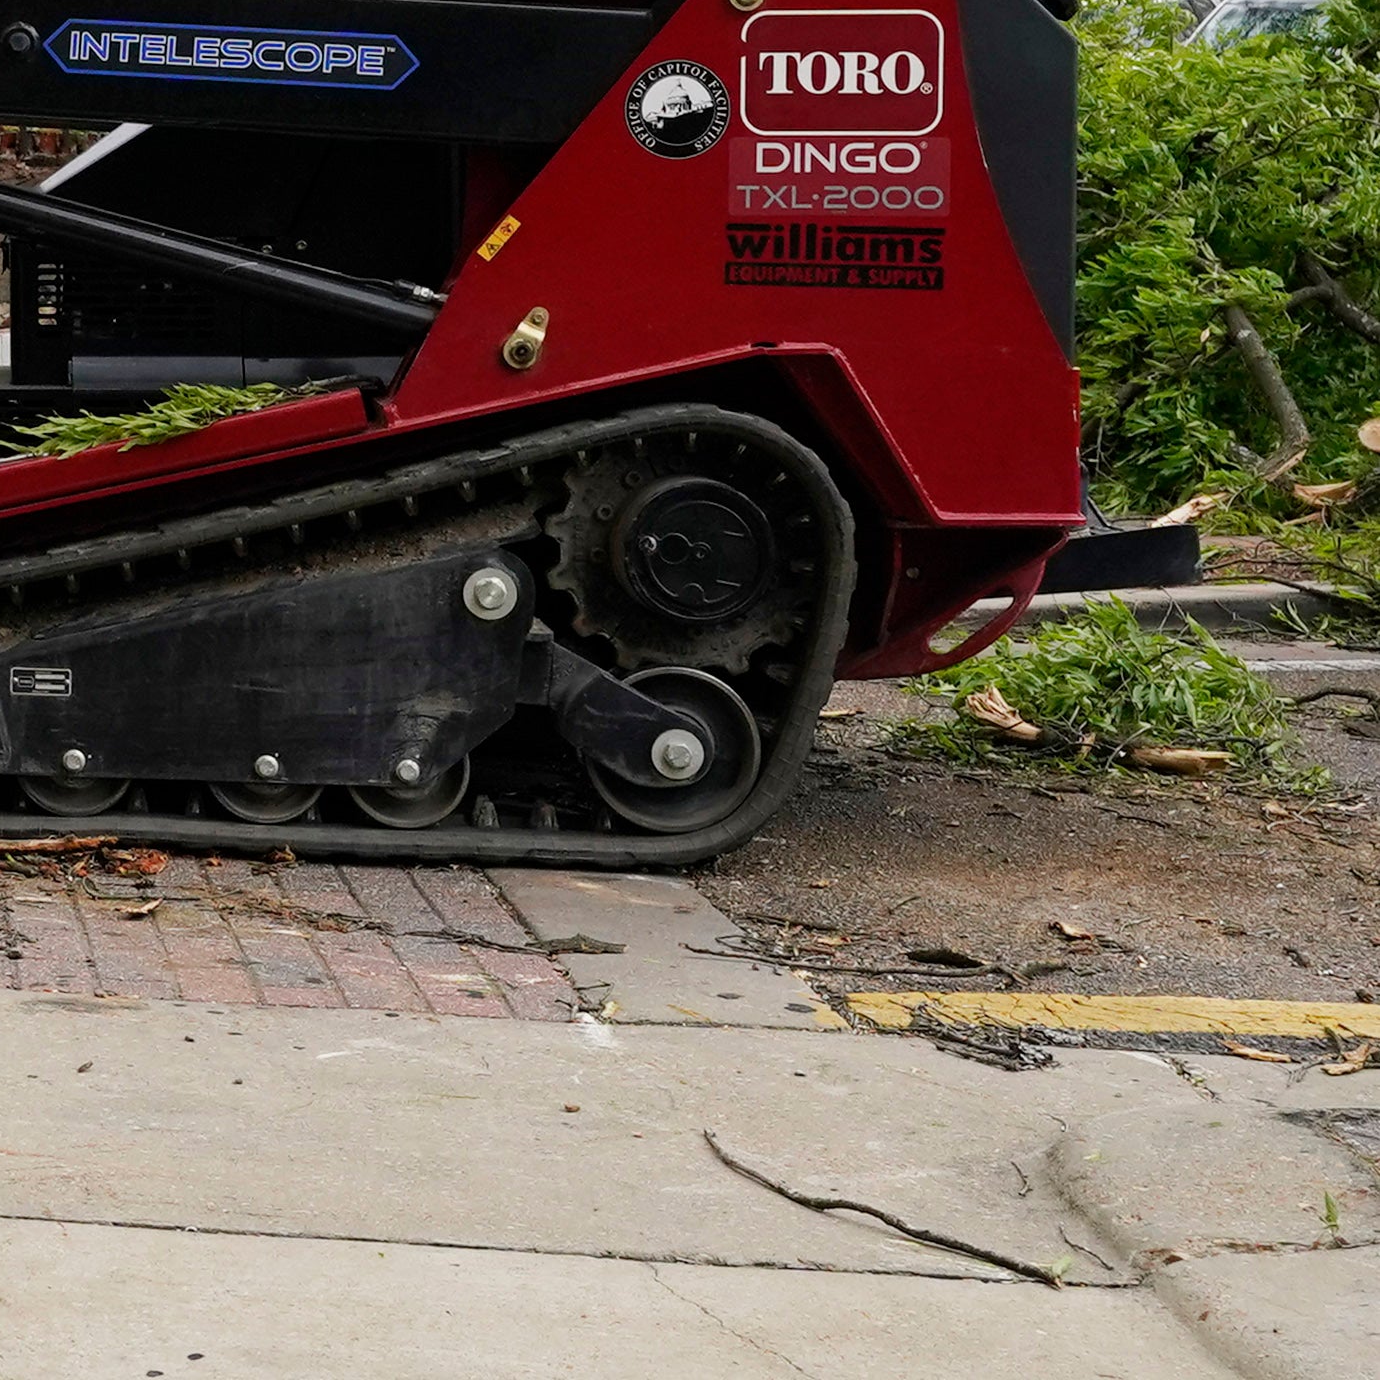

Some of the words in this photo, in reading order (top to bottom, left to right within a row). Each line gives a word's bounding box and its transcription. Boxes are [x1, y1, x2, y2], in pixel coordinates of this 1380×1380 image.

[69, 31, 385, 76] INTELESCOPE
[647, 63, 707, 82] CAPITOL
[758, 50, 926, 95] TORO
[632, 79, 647, 98] OF
[628, 101, 656, 148] OFFICE
[694, 80, 728, 151] FACILITIES
[755, 142, 922, 174] DINGO
[726, 223, 945, 264] williams
[729, 266, 839, 284] EQUIPMENT
[847, 270, 861, 284] &
[869, 269, 938, 286] SUPPLY
